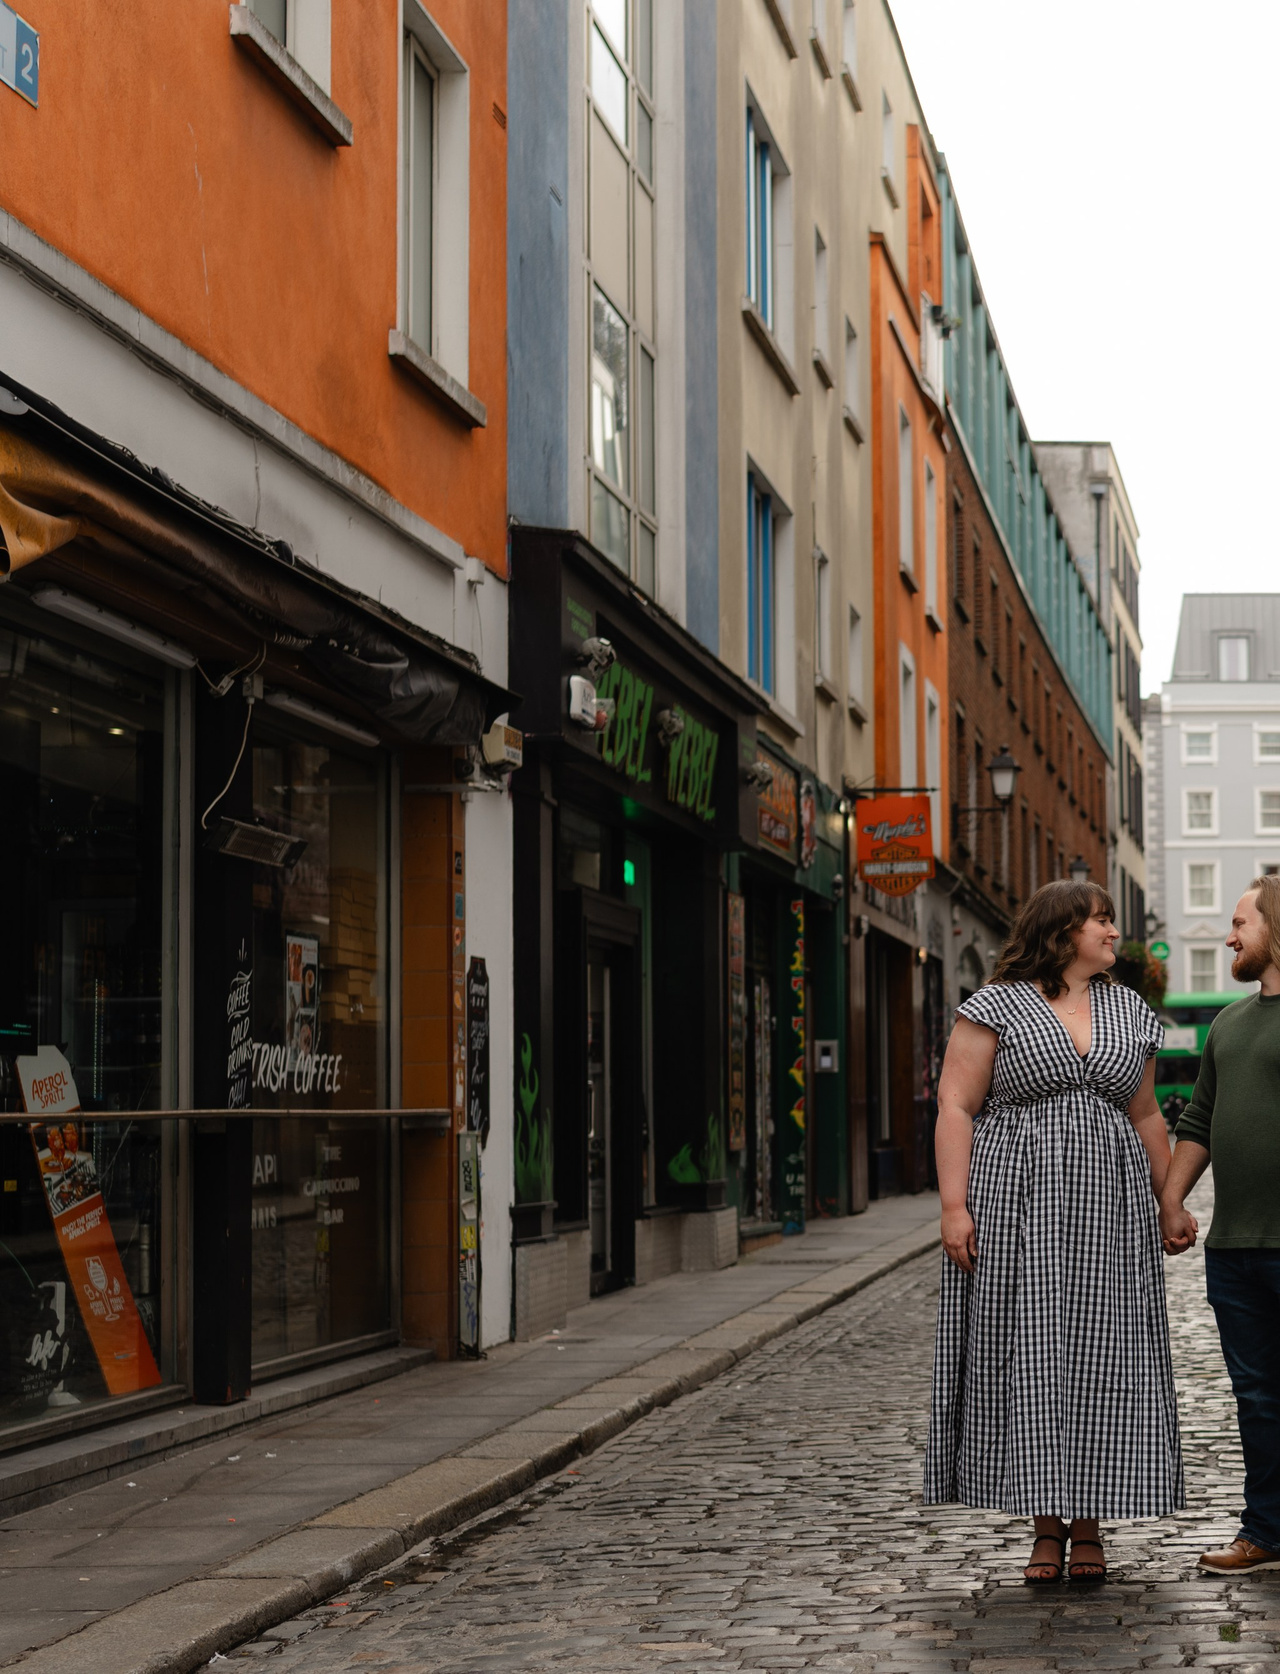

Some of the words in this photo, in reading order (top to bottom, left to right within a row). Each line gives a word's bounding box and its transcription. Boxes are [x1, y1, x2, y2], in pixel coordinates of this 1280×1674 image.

[21, 43, 34, 85] 2
[227, 981, 250, 1016] COFFEE
[231, 1016, 250, 1050] COLD
[227, 1036, 253, 1079] DRINKS
[252, 1042, 291, 1093] IRISH
[294, 1049, 343, 1094] COFFEE
[32, 1070, 68, 1100] APEROL
[40, 1088, 66, 1109] SPRITZ
[322, 1146, 342, 1162] THE
[303, 1176, 360, 1197] CAPPUCCINO
[323, 1208, 344, 1226] BAR
